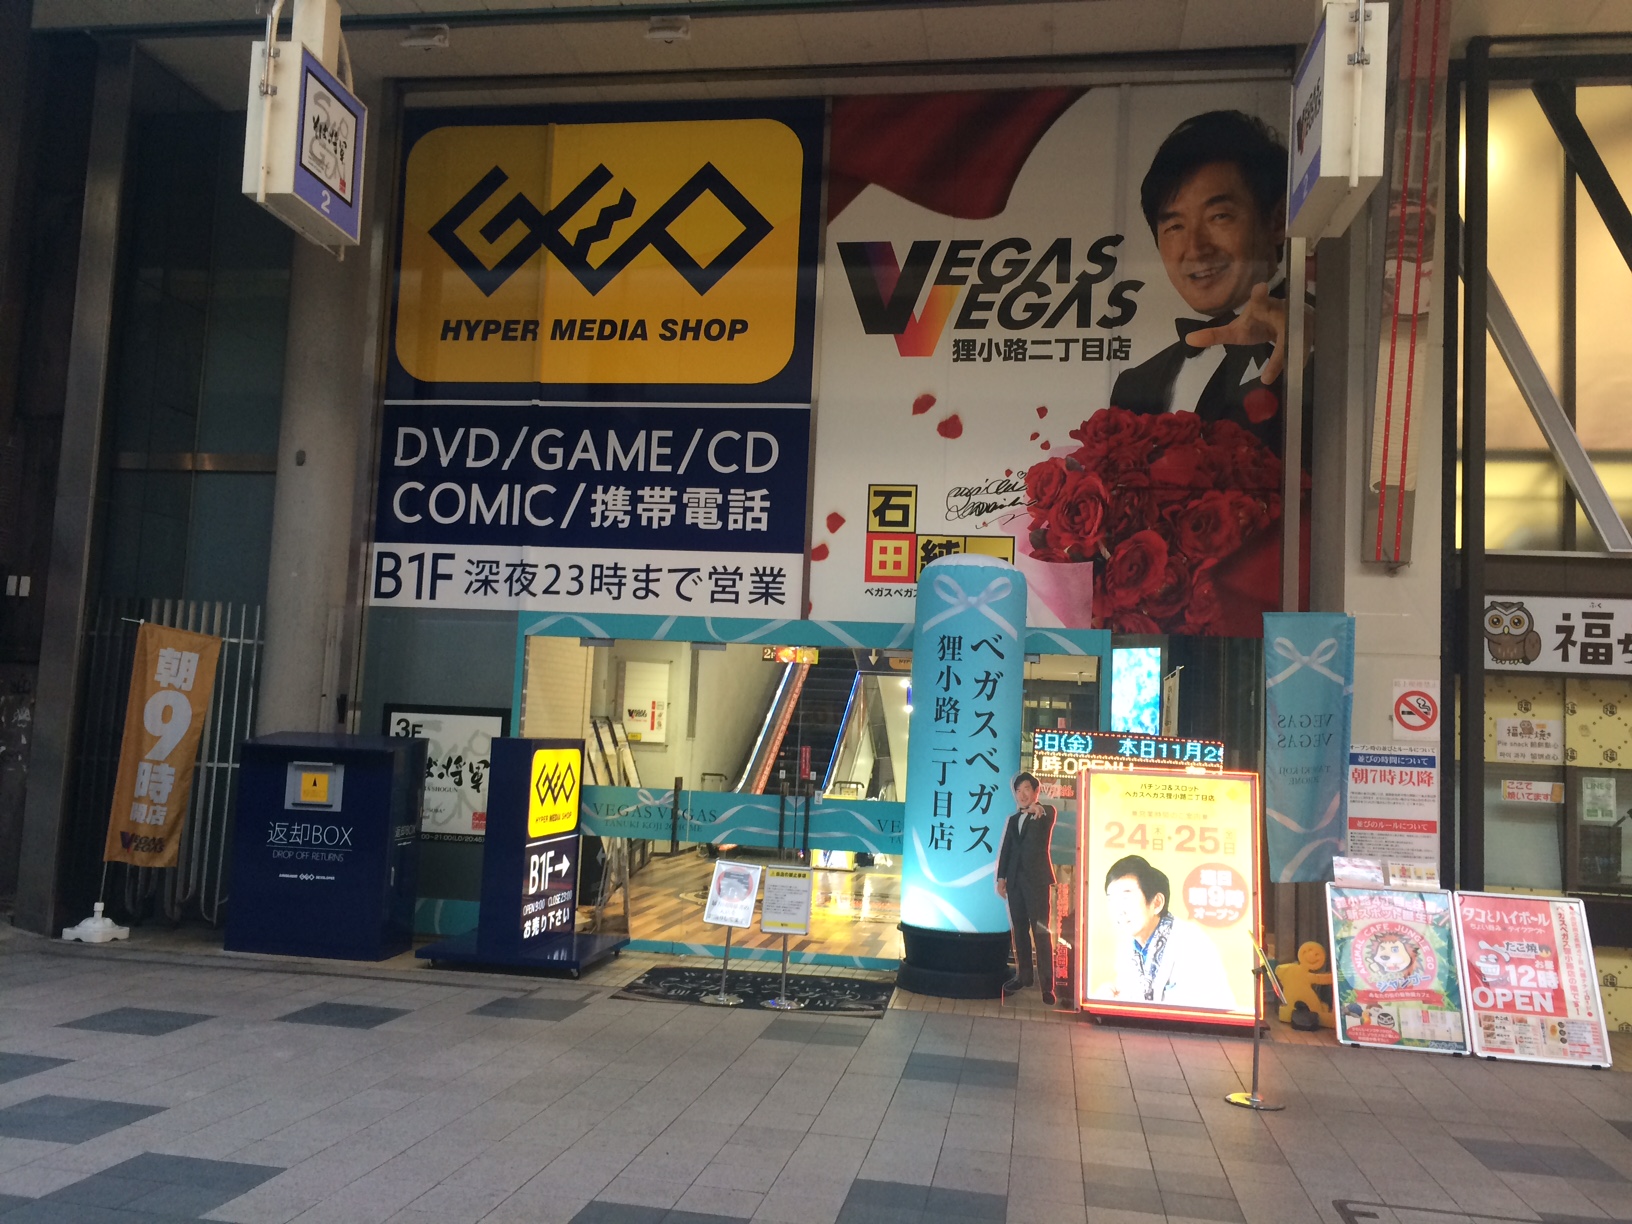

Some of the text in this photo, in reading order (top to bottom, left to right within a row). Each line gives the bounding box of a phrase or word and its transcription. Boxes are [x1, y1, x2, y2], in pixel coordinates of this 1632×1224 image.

[321, 190, 330, 214] 2
[428, 161, 775, 298] GEO
[836, 233, 1125, 335] VEGAS
[440, 319, 749, 341] HYPER MEDIA SHOP
[893, 279, 1146, 357] VEGAS
[952, 336, 1132, 362] 狸小路二丁目店
[393, 426, 780, 474] DVD/GAME/CD
[392, 481, 771, 532] COMIC/携帯電話
[373, 551, 787, 607] B1F 深夜23時まで営業
[763, 648, 776, 659] 2F
[927, 634, 964, 851] 狸小路二丁目店
[962, 633, 1006, 854] ベガスベガス
[1358, 755, 1429, 766] 並びの時間について
[1352, 768, 1435, 788] 朝7時以降
[1507, 782, 1533, 790] ここで
[1507, 792, 1552, 802] 焼いてます
[592, 802, 652, 819] VEGAS
[266, 822, 354, 846] 返却BOX
[605, 820, 640, 829] TANUKI
[642, 821, 663, 832] KOJI
[1104, 821, 1150, 850] 24
[1174, 824, 1220, 854] 25
[1356, 820, 1429, 830] 並びのルールについて
[272, 850, 344, 863] DROP OFF RETURNS
[528, 850, 556, 896] B1F
[523, 907, 570, 940] お売り下さい
[1194, 907, 1240, 920] オープン
[1462, 907, 1550, 926] タコとハイボール
[1364, 923, 1390, 937] CAFE
[1394, 924, 1430, 952] JUNGLE
[1426, 956, 1434, 970] GO
[1505, 942, 1539, 954] たこ焼
[1504, 964, 1559, 990] 12時
[1472, 986, 1555, 1013] OPEN
